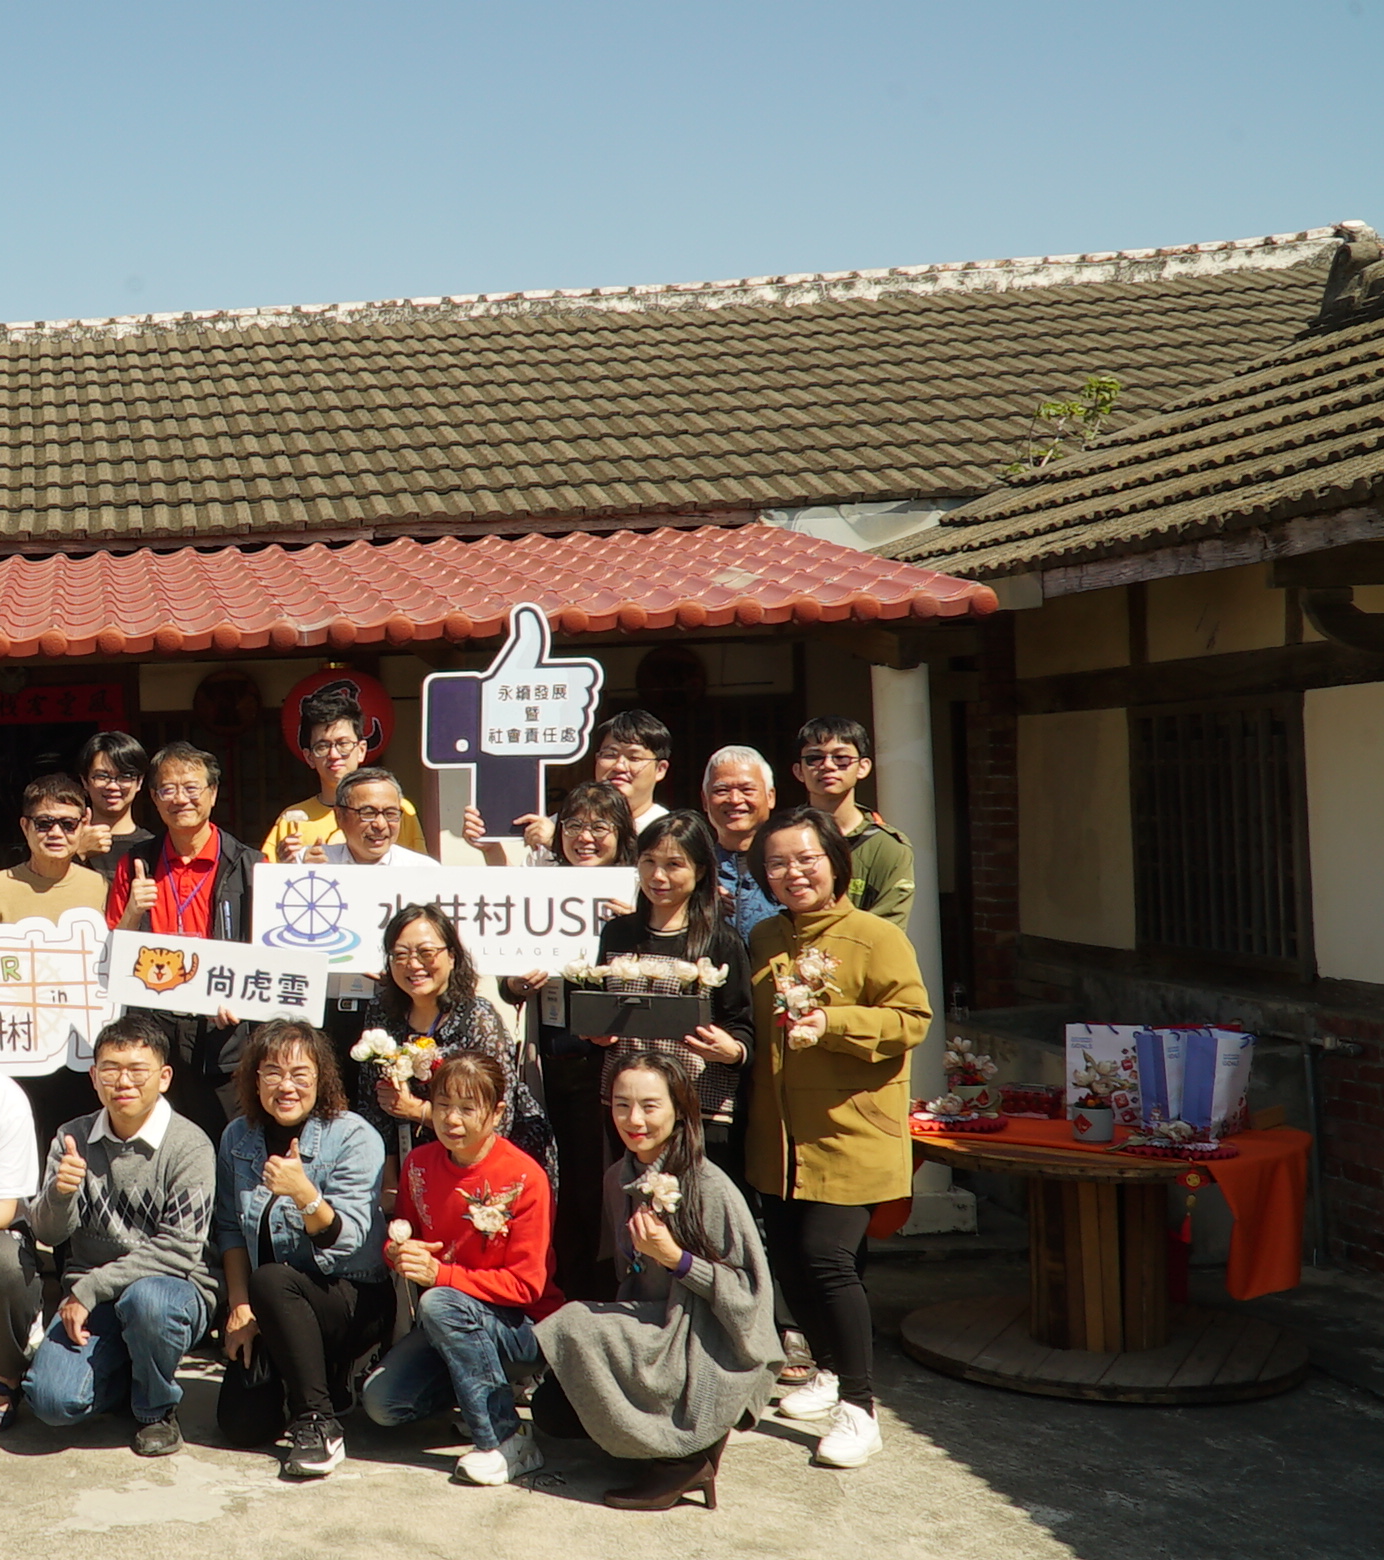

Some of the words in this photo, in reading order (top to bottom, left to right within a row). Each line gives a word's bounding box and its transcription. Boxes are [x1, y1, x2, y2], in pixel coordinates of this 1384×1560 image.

[497, 683, 568, 701] 永續發展
[524, 705, 540, 722] 暨
[487, 726, 576, 744] 社會責任處
[469, 947, 559, 956] ILLAGE
[206, 965, 309, 1007] 尚虎雲
[50, 990, 68, 1003] in
